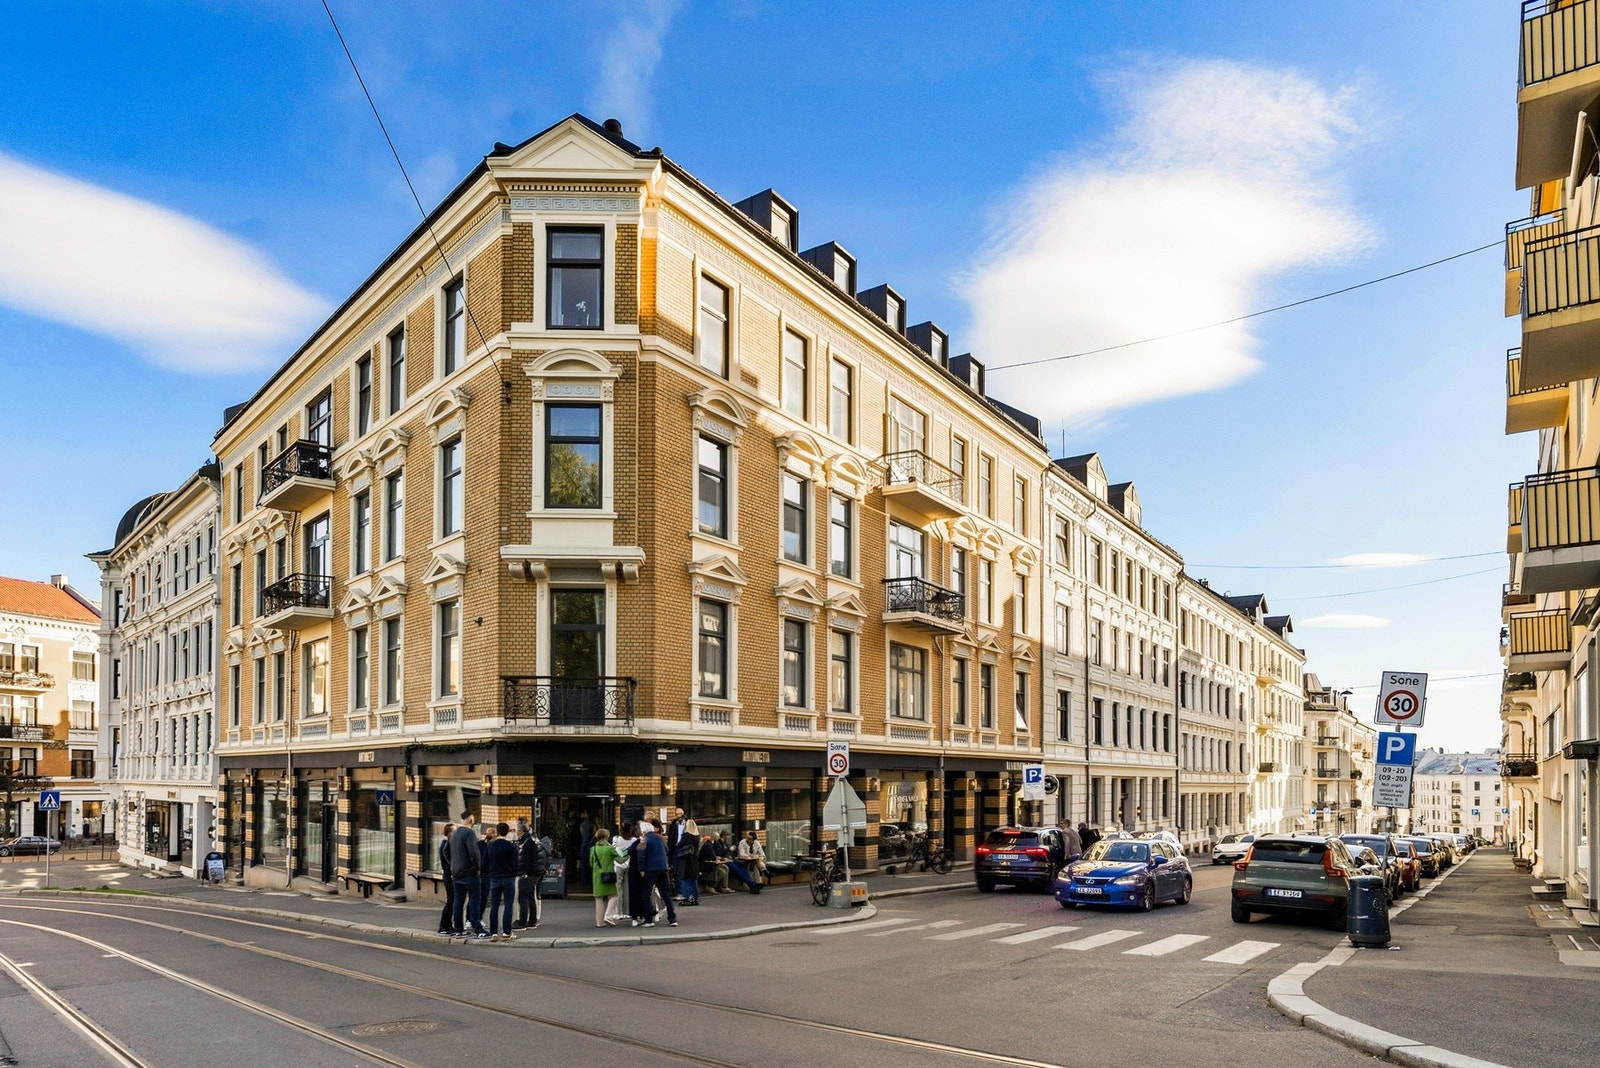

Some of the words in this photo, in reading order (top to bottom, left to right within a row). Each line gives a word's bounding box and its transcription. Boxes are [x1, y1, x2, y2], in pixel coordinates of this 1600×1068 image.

[1390, 675, 1419, 685] Sone
[1391, 698, 1412, 712] 30
[1385, 736, 1405, 760] P
[834, 759, 844, 768] 30
[1029, 770, 1038, 781] P
